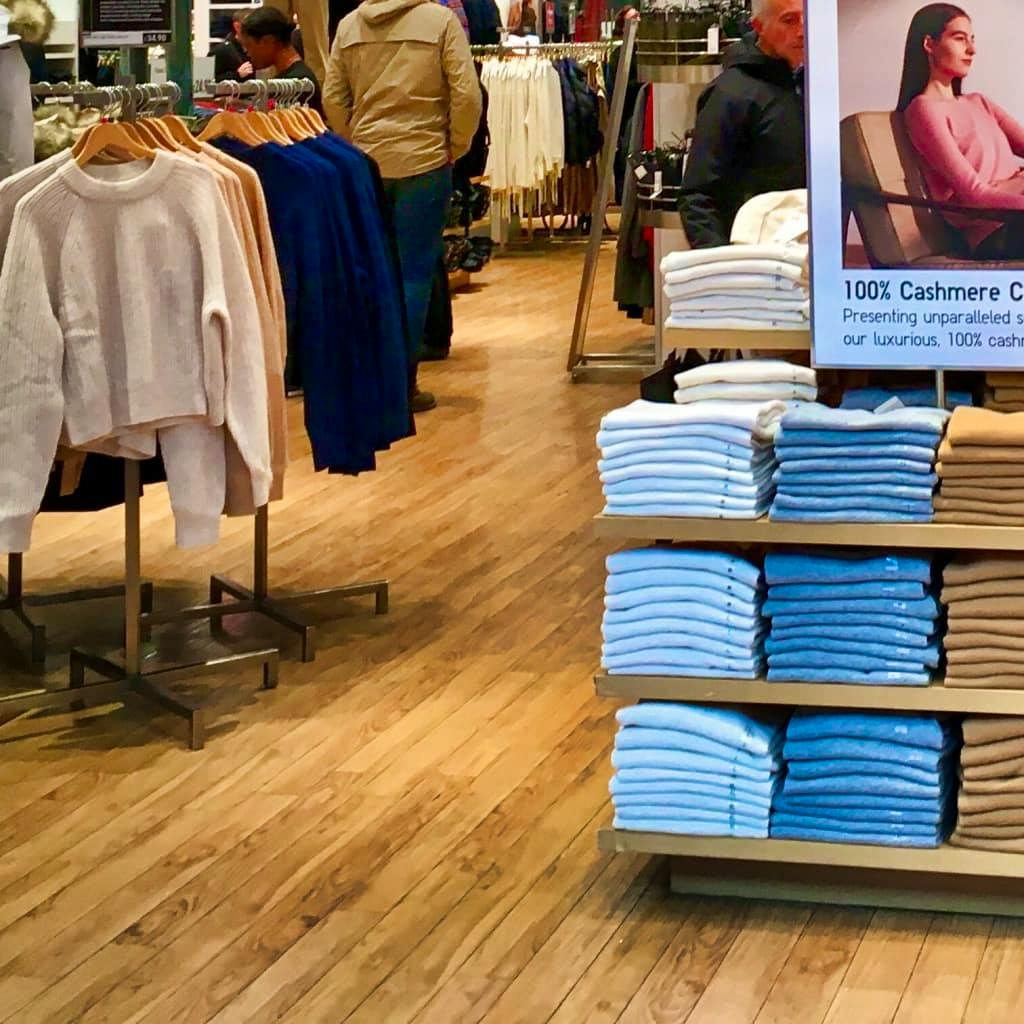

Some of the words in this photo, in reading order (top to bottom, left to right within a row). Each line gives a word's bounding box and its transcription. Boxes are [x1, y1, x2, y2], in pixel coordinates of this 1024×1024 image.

[844, 279, 891, 301] 100%
[899, 280, 1001, 302] Cashmere
[842, 308, 917, 326] Presenting
[923, 309, 1011, 328] unparalleled
[842, 334, 867, 347] our
[873, 331, 941, 349] luxurious,
[948, 332, 983, 348] 100%
